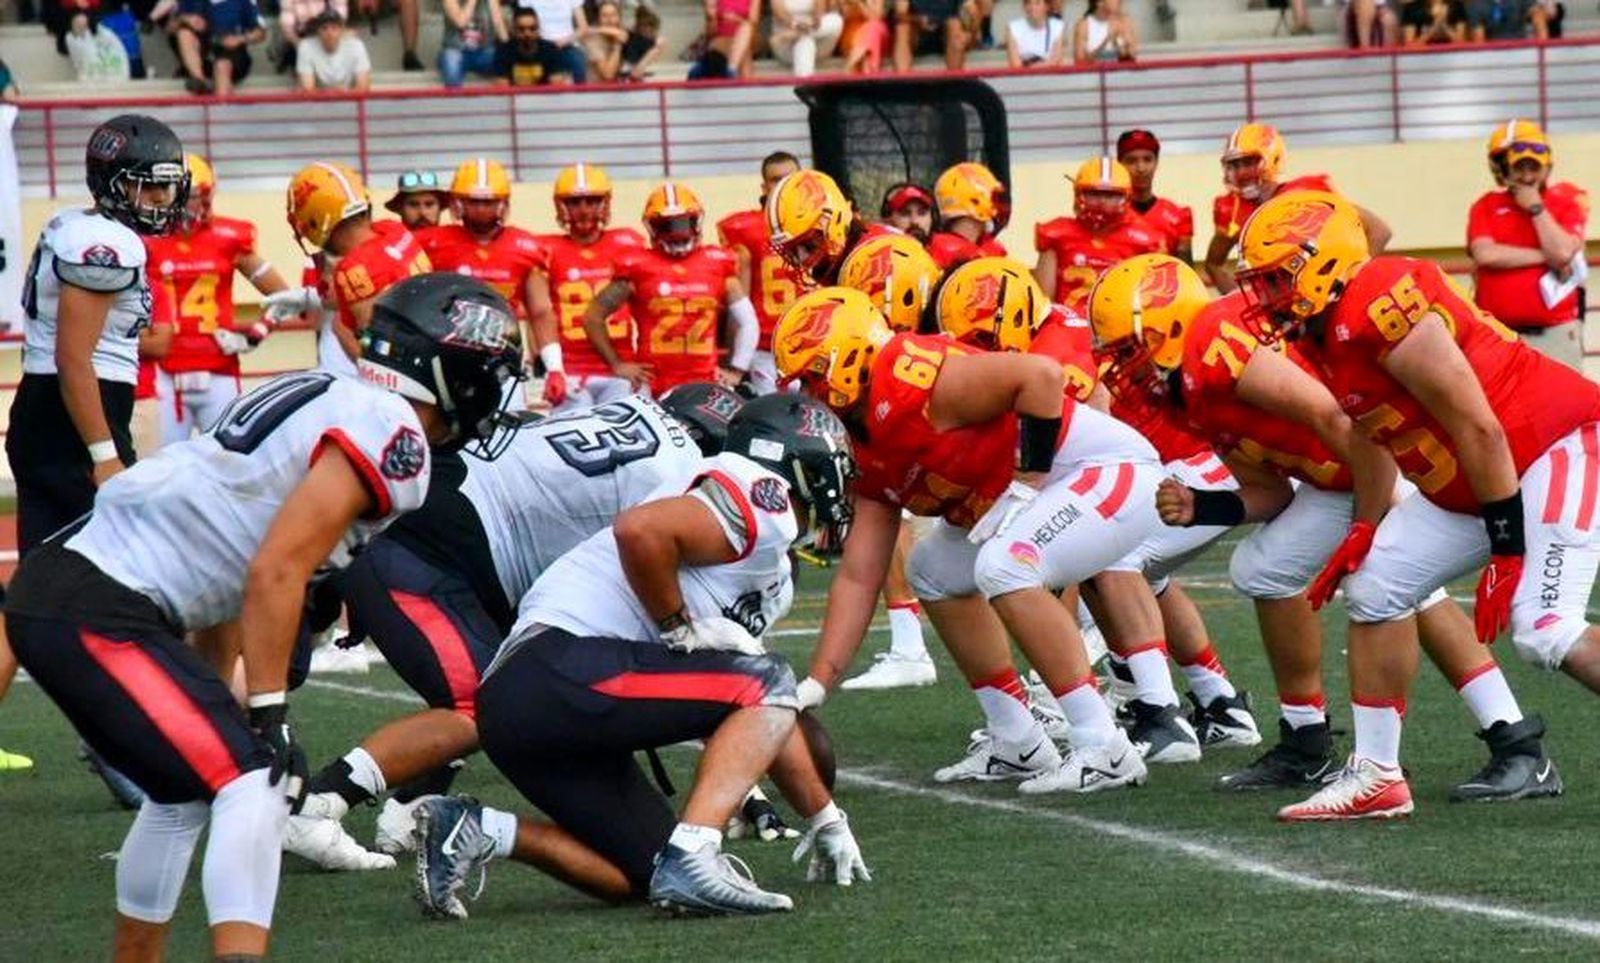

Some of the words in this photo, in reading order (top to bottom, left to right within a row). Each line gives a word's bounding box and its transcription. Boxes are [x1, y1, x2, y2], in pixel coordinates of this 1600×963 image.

[649, 297, 718, 354] 22
[1367, 273, 1430, 342] 65
[893, 340, 944, 390] 61
[1202, 320, 1258, 379] 71
[1031, 503, 1083, 548] HEX.COM
[1541, 543, 1566, 609] HEX.COM
